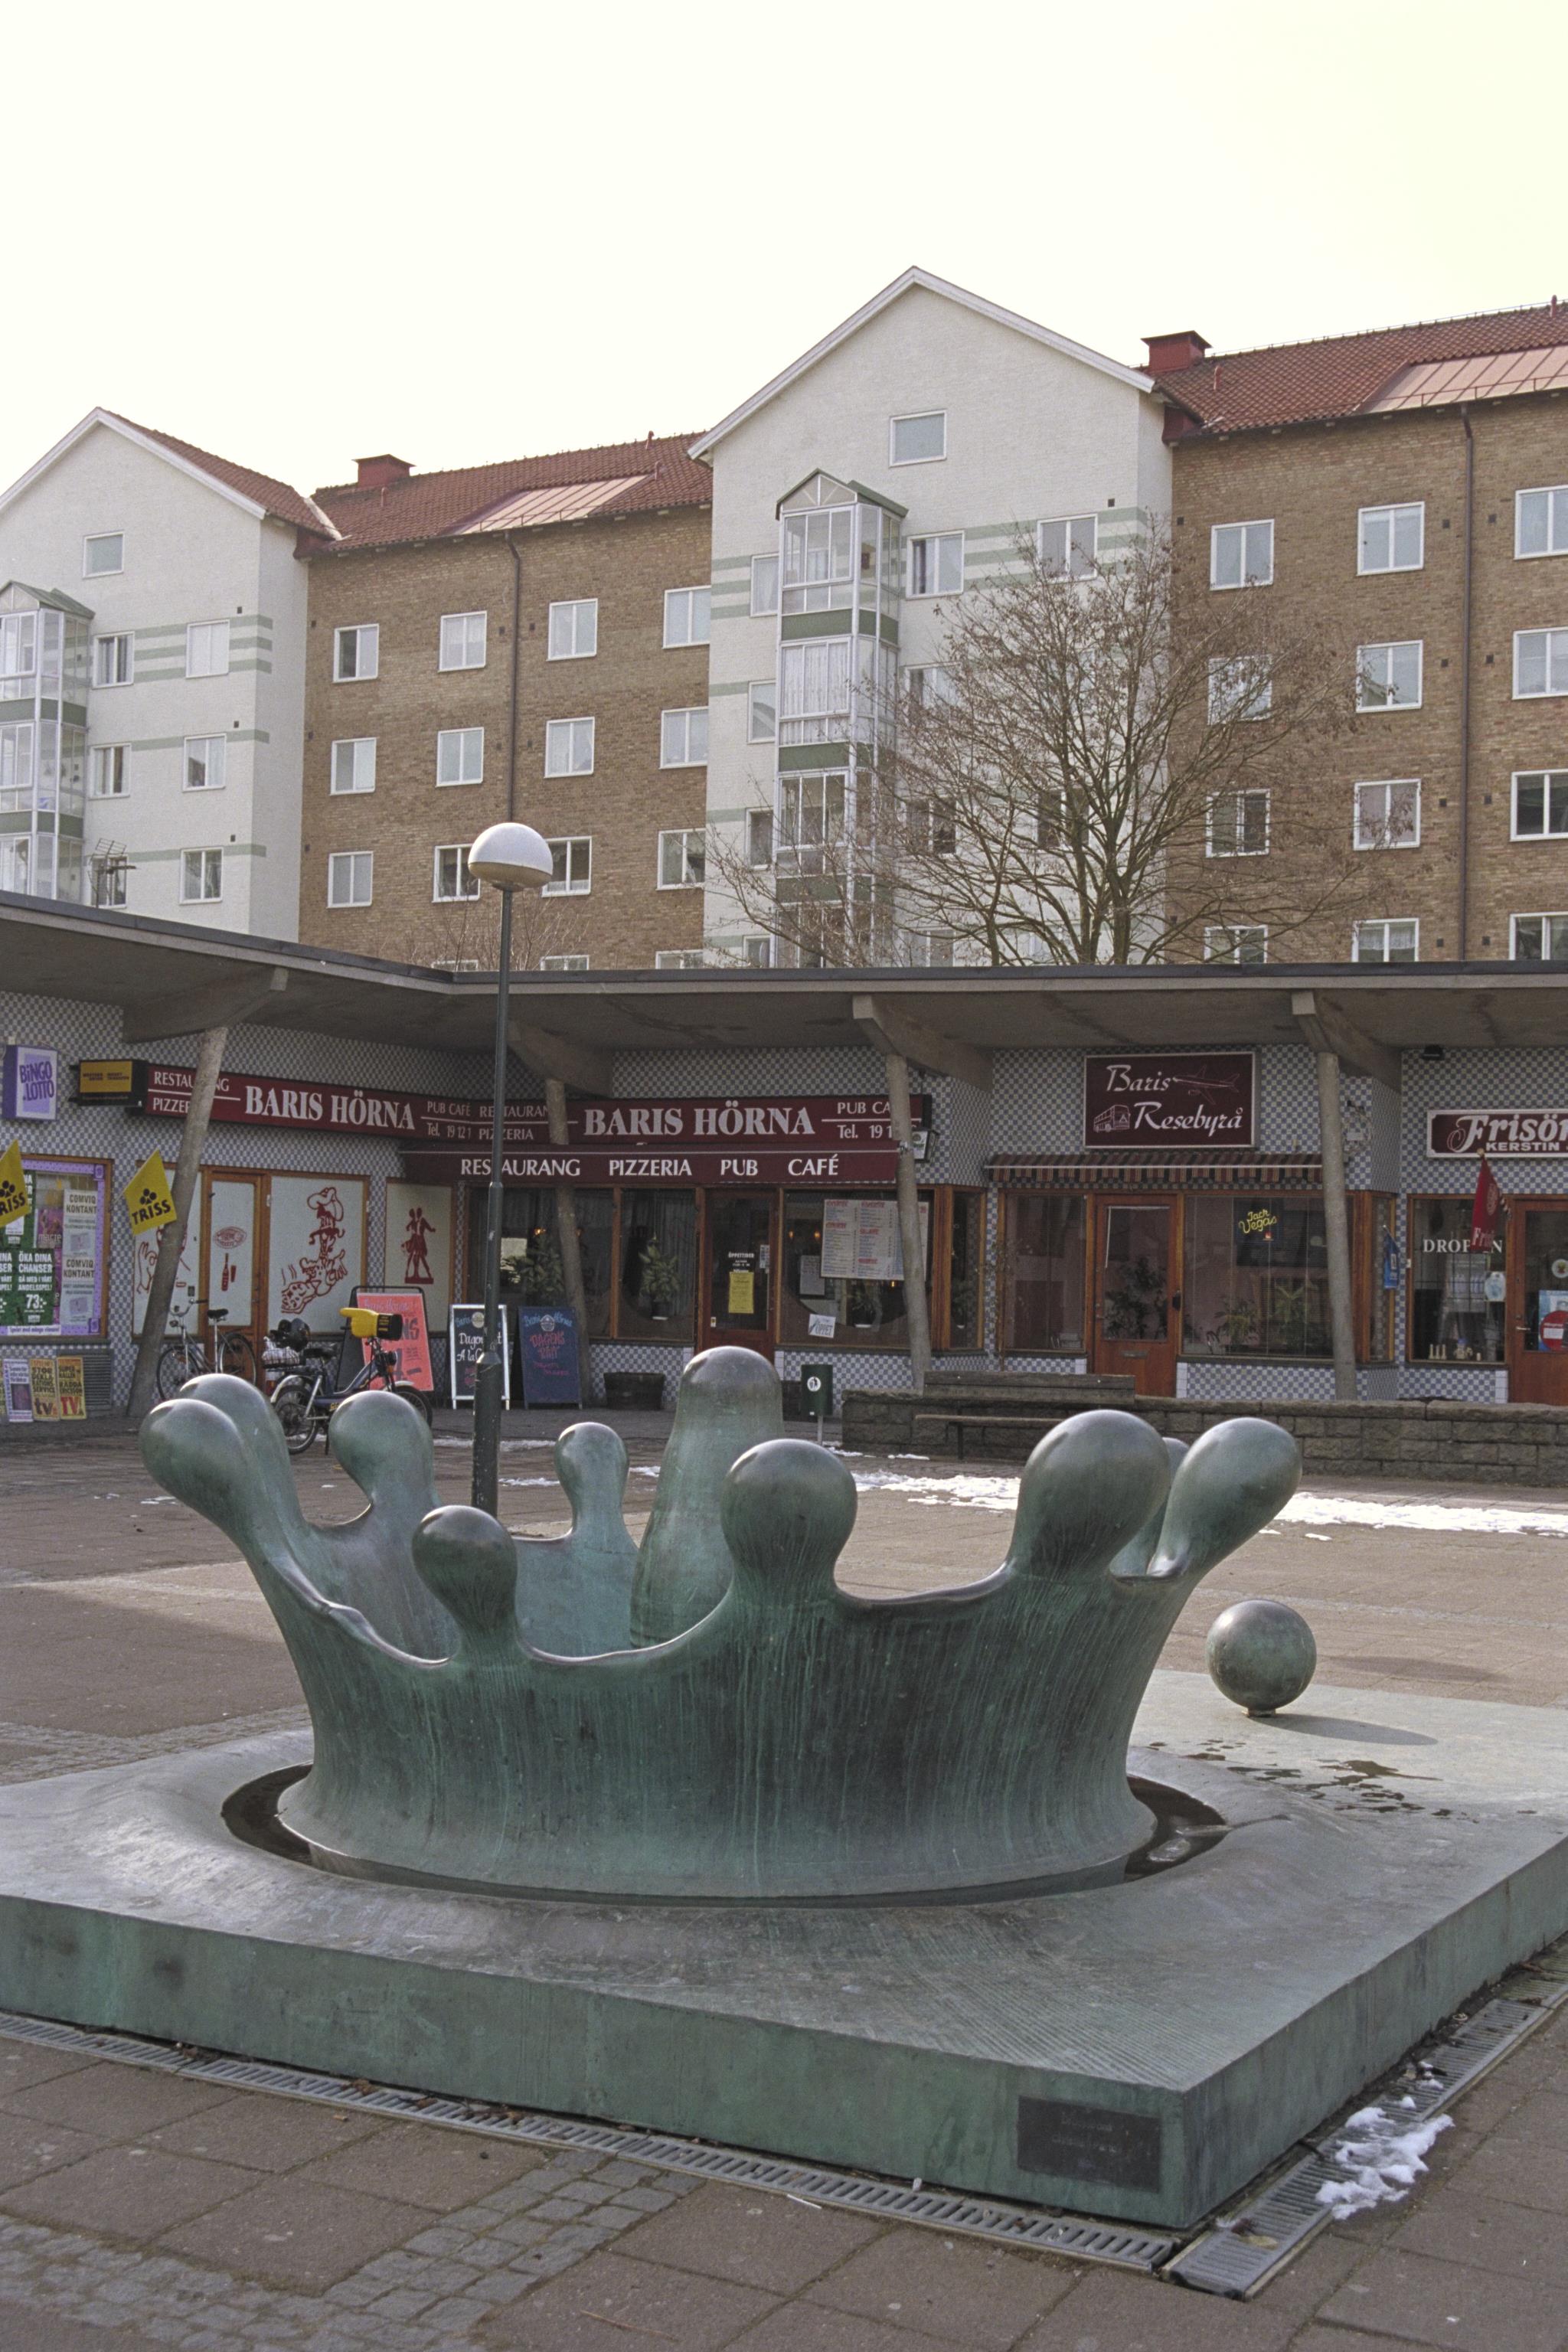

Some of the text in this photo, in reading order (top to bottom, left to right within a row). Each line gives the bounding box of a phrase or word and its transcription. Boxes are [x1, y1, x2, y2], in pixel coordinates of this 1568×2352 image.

[154, 1071, 230, 1092] RESTAUNG
[1106, 1064, 1171, 1092] Baris
[152, 1097, 190, 1113] PIZZER
[245, 1085, 416, 1131] BARIS HÖRNA
[426, 1100, 472, 1117] PUB CAFÉ
[479, 1105, 549, 1118] RETAURAN
[837, 1101, 891, 1115] PUB CA
[583, 1099, 816, 1136] BARIS HÖRNA
[1133, 1101, 1244, 1137] Resebyrå
[427, 1122, 441, 1137] Tel.
[447, 1125, 456, 1138] 19
[457, 1125, 466, 1139] 12
[837, 1124, 859, 1139] Tel.
[869, 1125, 884, 1139] 19
[1486, 1142, 1560, 1152] KERSTIN
[461, 1153, 839, 1177] RESAURANG PIZZERIA PUB CAFÉ
[0, 1191, 26, 1217] RISS
[69, 1194, 96, 1204] COMVIQ
[66, 1204, 97, 1214] KONTANT
[131, 1199, 172, 1225] TRISS
[1247, 1208, 1270, 1222] Jack
[1238, 1216, 1278, 1233] Vegas
[18, 1250, 53, 1263] ÖKA DINA
[66, 1259, 94, 1269] COMVIQ
[18, 1263, 53, 1273] CHANSER
[63, 1269, 94, 1279] KONTANT
